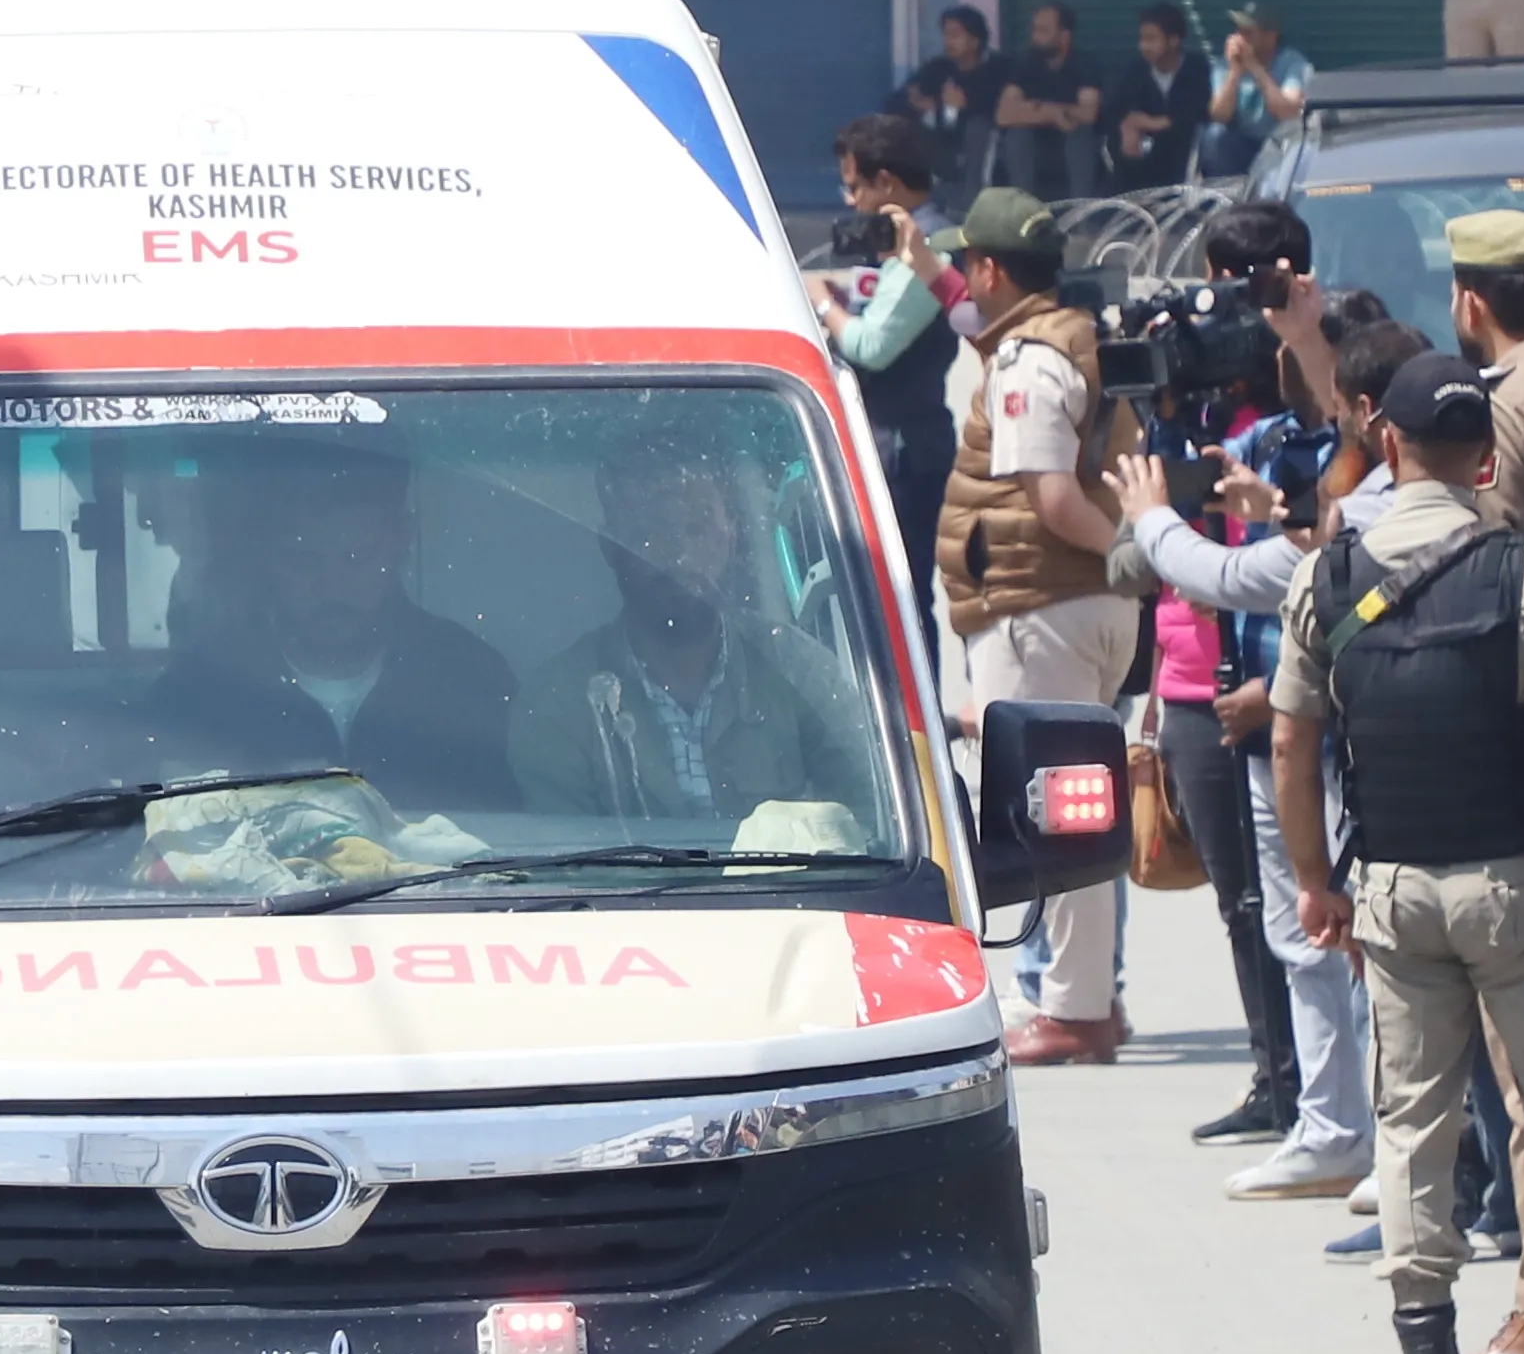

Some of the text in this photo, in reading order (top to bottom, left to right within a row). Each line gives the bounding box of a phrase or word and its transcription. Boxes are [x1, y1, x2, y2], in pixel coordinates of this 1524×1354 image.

[161, 162, 195, 188] OF
[209, 163, 317, 190] HEALTH
[329, 164, 483, 198] SERVICES,
[148, 193, 289, 220] KASHMIR
[142, 229, 299, 264] EMS
[132, 396, 154, 420] &
